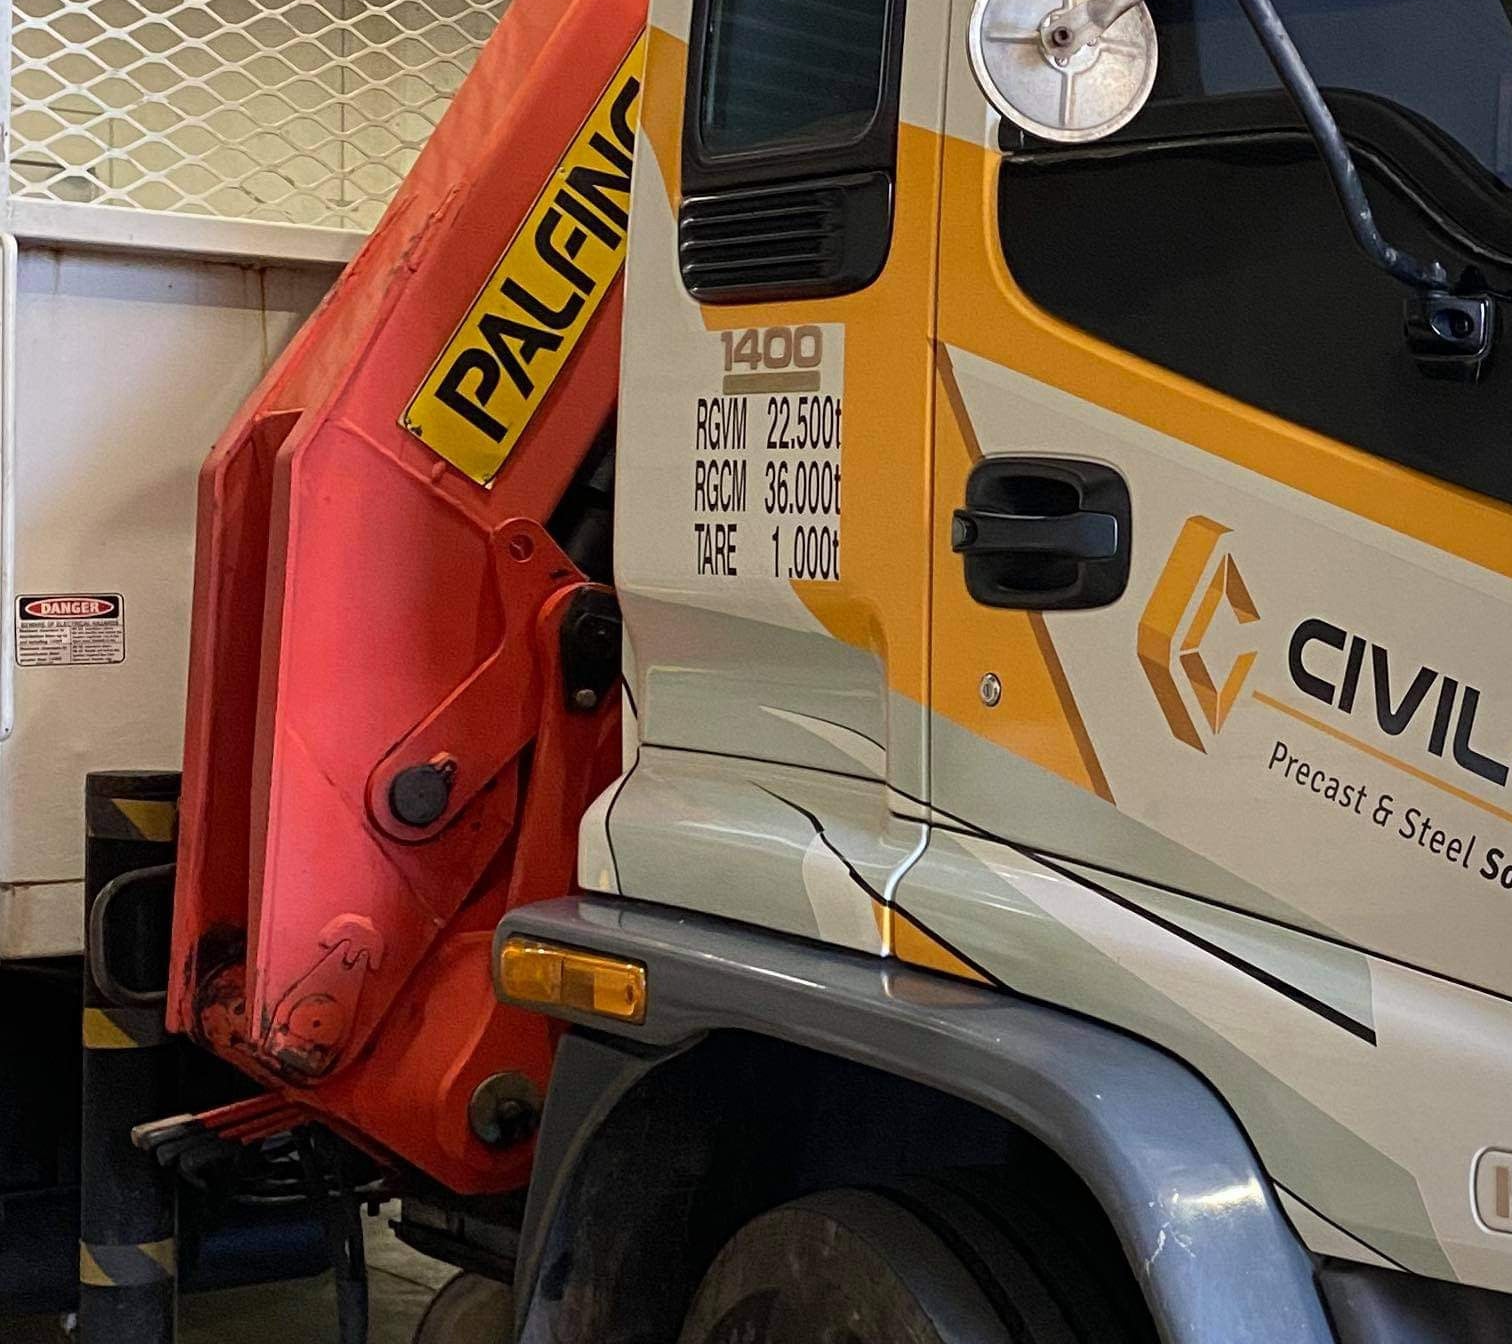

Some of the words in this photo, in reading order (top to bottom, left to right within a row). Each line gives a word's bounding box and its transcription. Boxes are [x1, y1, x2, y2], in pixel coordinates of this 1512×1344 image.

[720, 325, 823, 372] 1400
[696, 397, 747, 450] RGVM
[766, 395, 841, 450] 22.500t
[694, 459, 746, 513] RGCM
[764, 460, 841, 515] 36.000t
[694, 523, 737, 576] TARE
[40, 601, 99, 614] DANGER
[1268, 740, 1368, 814] Precast
[1372, 794, 1394, 827] &
[1398, 807, 1477, 869] Steel
